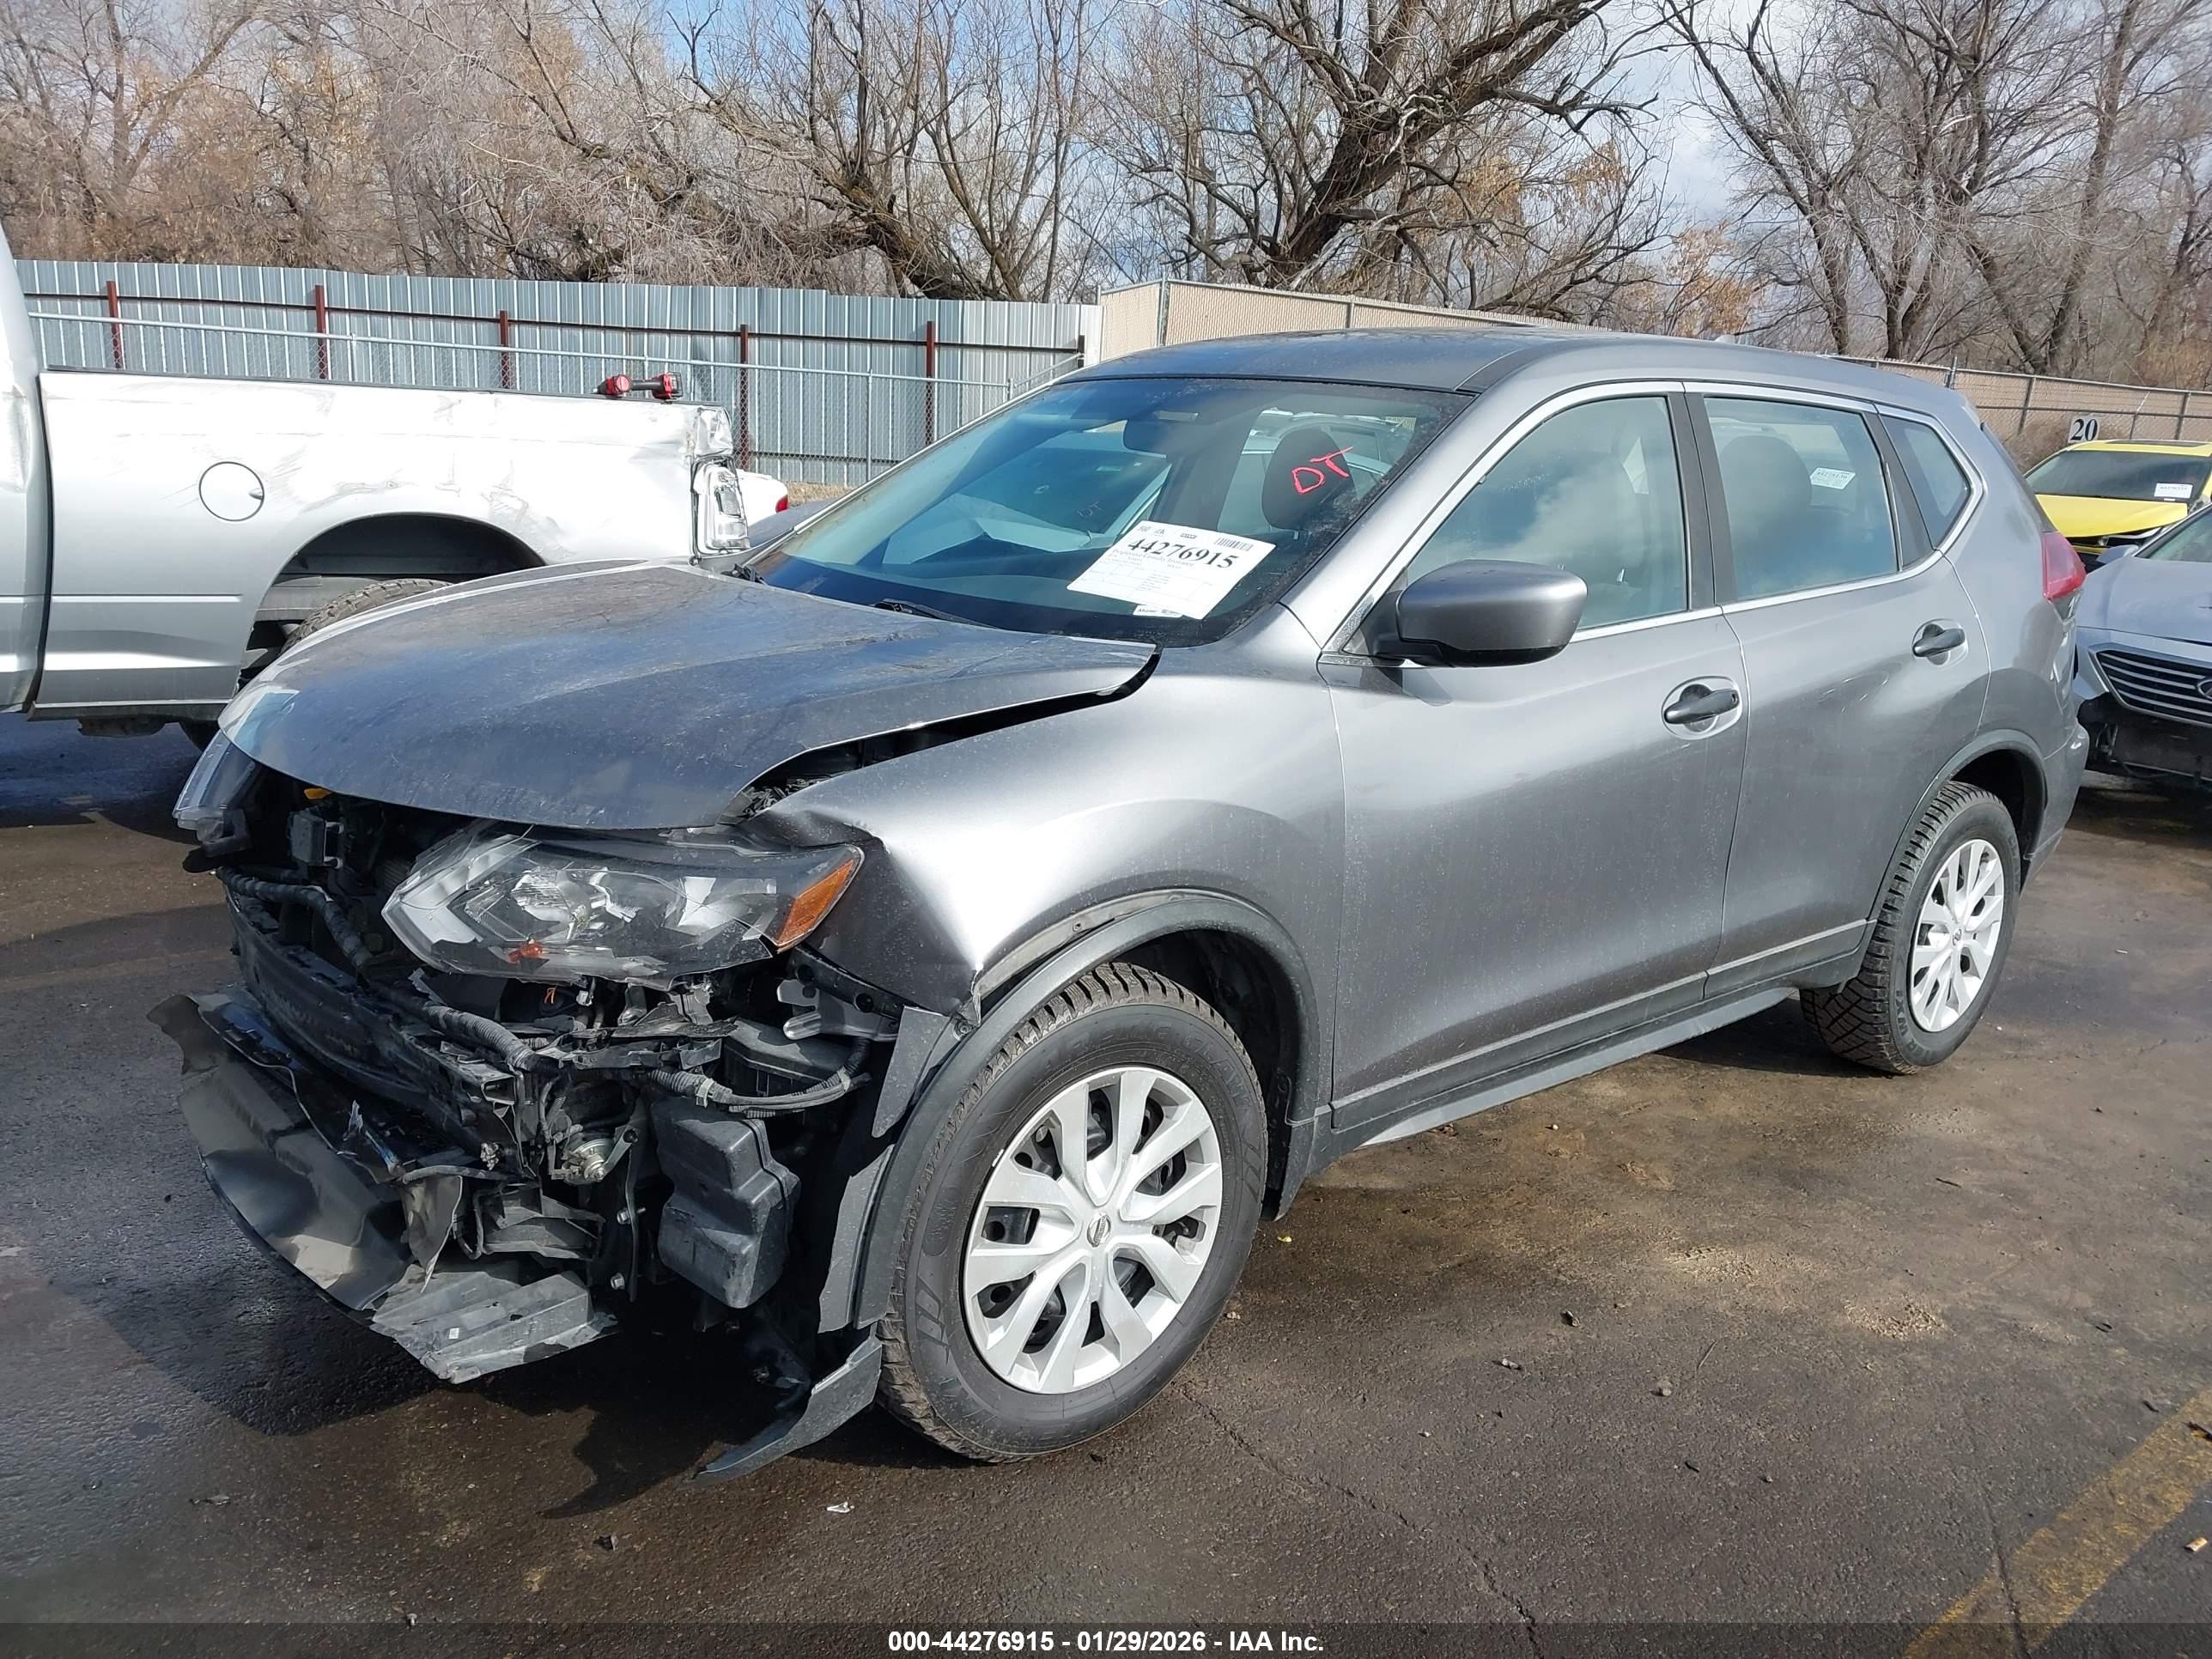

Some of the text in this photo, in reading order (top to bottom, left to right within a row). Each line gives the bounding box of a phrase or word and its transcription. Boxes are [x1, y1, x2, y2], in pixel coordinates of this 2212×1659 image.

[2070, 417, 2099, 441] 20
[1291, 446, 1353, 494] DT
[1127, 538, 1239, 568] 44276915
